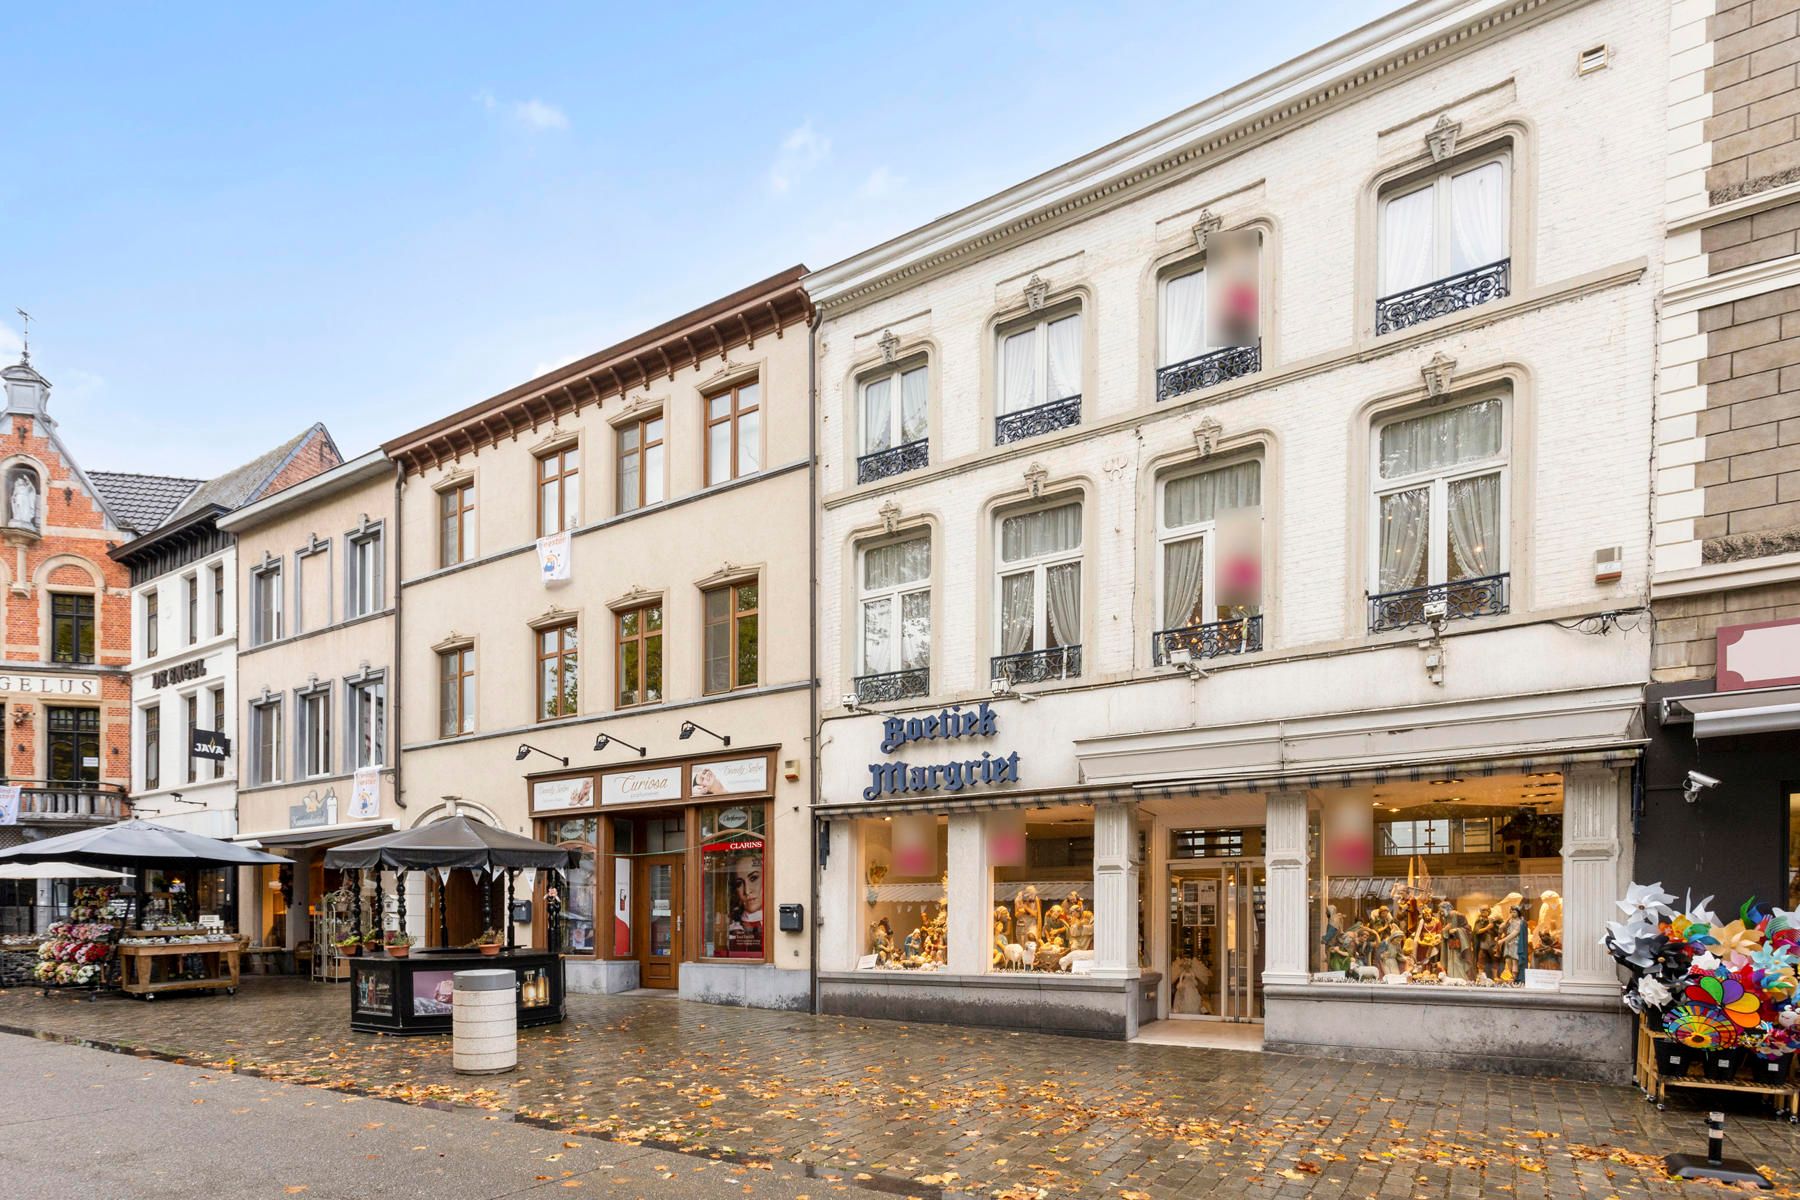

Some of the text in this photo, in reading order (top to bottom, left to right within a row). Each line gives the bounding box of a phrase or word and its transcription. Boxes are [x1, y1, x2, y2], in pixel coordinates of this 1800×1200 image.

[169, 659, 207, 684] ENGEL
[880, 702, 998, 754] Boetiek
[194, 743, 225, 756] JAVA
[614, 774, 669, 794] Curiosa
[863, 751, 1020, 800] Margriet
[730, 841, 762, 850] CLARINS
